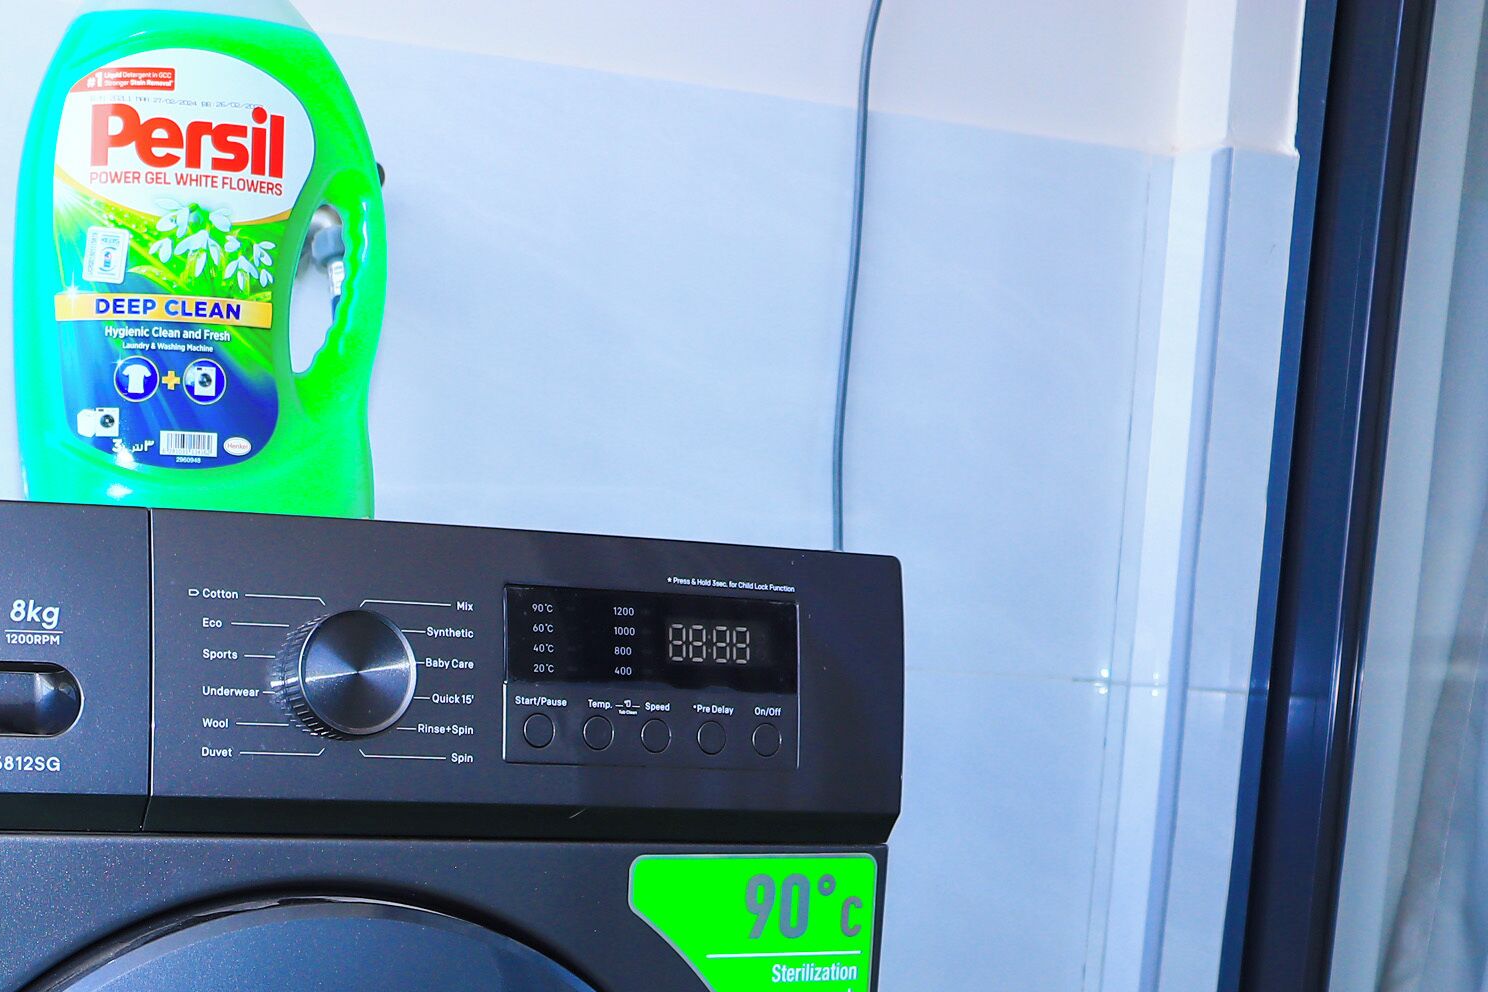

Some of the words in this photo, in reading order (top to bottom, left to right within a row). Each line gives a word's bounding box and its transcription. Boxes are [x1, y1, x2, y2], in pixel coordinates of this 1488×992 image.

[90, 103, 285, 180] Persil
[89, 171, 141, 185] POWER
[145, 173, 172, 186] GEL
[175, 174, 219, 189] WHITE
[221, 176, 283, 196] FLOWERS
[95, 298, 157, 315] DEEP
[164, 299, 241, 320] CLEAN
[104, 325, 150, 339] Hygienic
[152, 326, 181, 339] Clean
[182, 328, 202, 340] and
[203, 329, 231, 342] Fresh
[122, 342, 150, 351] Laundry
[150, 342, 156, 350] &
[157, 342, 186, 353] Washing
[186, 343, 214, 353] Machine
[673, 576, 691, 585] Press
[697, 579, 711, 587] Hold
[729, 580, 738, 588] for
[738, 581, 754, 590] Child
[754, 582, 769, 591] Lock
[769, 584, 796, 593] Function
[202, 588, 239, 600] Cotton
[456, 601, 474, 612] Mix
[613, 606, 635, 617] 1200
[9, 599, 60, 631] 8kg
[202, 618, 223, 628] Eco
[426, 626, 474, 639] Synthetic
[613, 626, 636, 637] 1000
[5, 633, 61, 646] 1200RPM
[202, 649, 238, 661] Sports
[614, 646, 632, 656] 800
[425, 658, 450, 670] Baby
[451, 659, 474, 670] Care
[614, 666, 632, 676] 400
[202, 686, 260, 697] Underwear
[432, 693, 461, 704] Quick
[514, 695, 568, 707] Start/Pause
[588, 699, 613, 709] Temp.
[644, 702, 670, 712] Speed
[711, 704, 734, 716] Delay
[754, 706, 781, 716] On/Off
[202, 718, 229, 729] Wool
[417, 724, 474, 736] Rinse+Spin
[201, 746, 233, 758] Duvet
[451, 752, 474, 764] Spin
[771, 962, 857, 983] Sterilization
